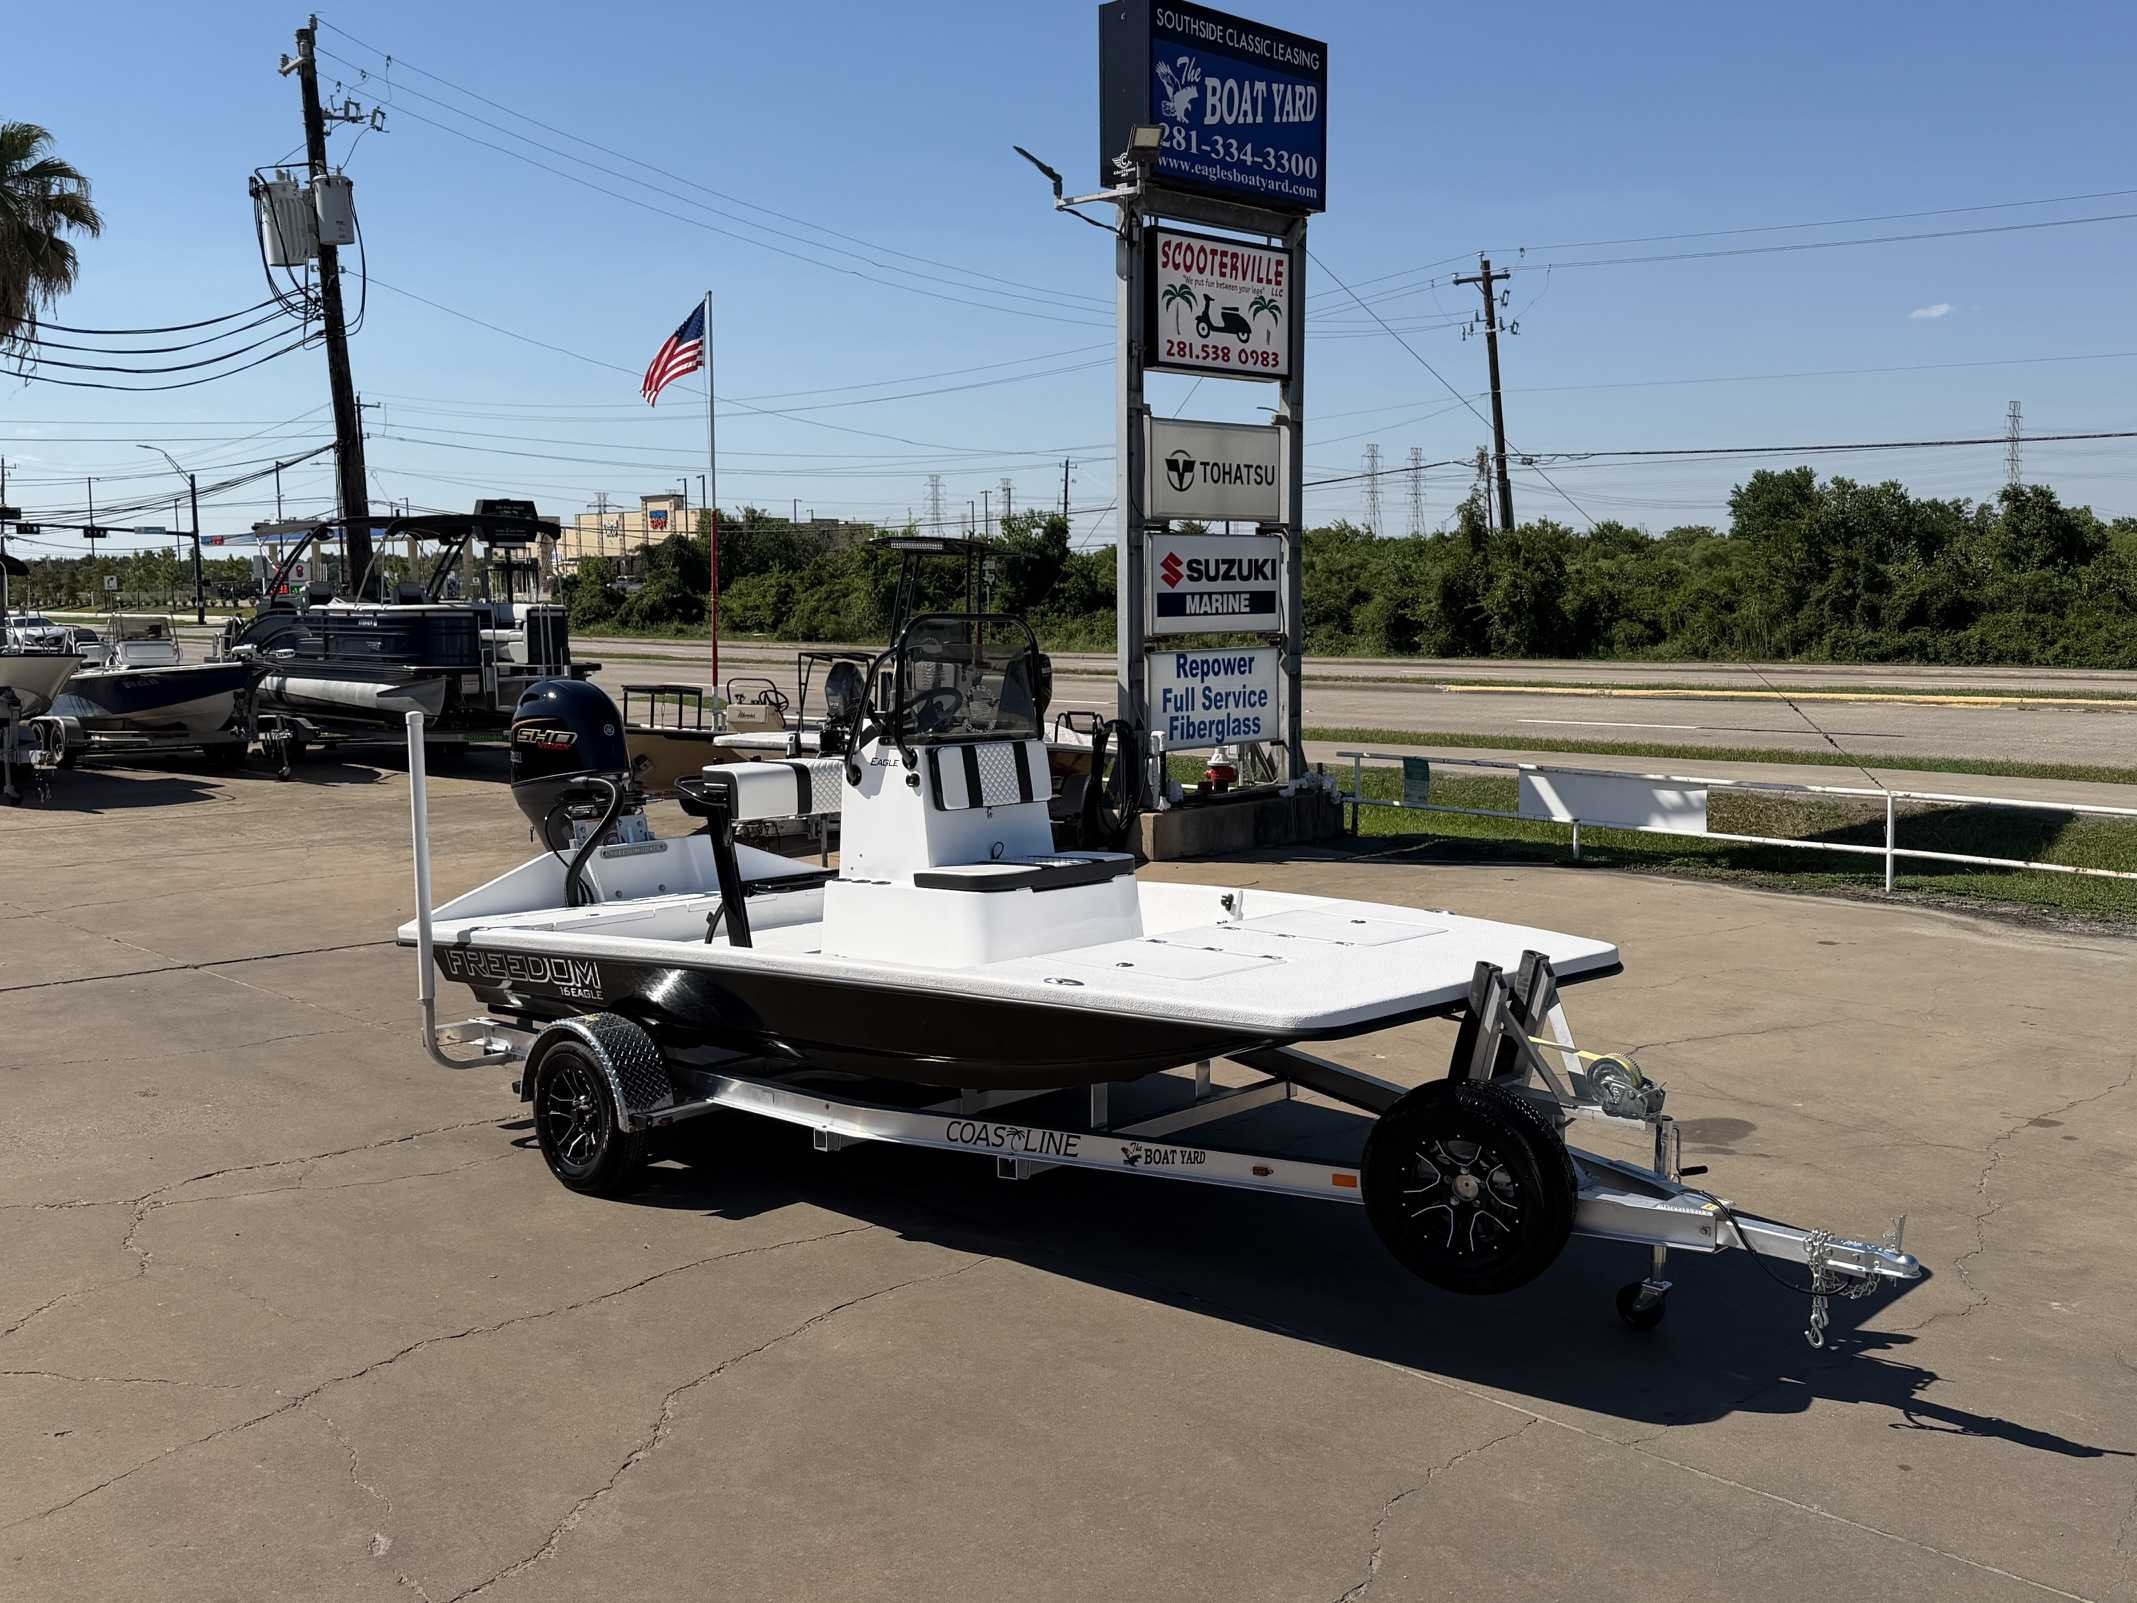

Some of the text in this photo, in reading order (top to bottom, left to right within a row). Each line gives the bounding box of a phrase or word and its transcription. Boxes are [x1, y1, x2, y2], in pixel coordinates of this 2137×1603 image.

[1156, 8, 1319, 71] SOUTHSIDE CLASSIC LEASING
[1176, 56, 1202, 85] The
[1203, 77, 1317, 126] BOAT YARD
[1158, 122, 1318, 180] 281-334-3300
[1161, 239, 1284, 287] SCOOTERVILLE
[1194, 278, 1205, 290] put
[1205, 278, 1215, 289] fun
[1238, 285, 1251, 296] your
[1271, 288, 1284, 298] LLC
[1166, 339, 1280, 368] 281.538 0983
[1199, 461, 1275, 487] TOHATSU
[1186, 558, 1277, 583] SUZUKI
[1185, 593, 1250, 615] MARINE
[1175, 653, 1255, 684] Repower
[1162, 684, 1268, 713] Full Service
[516, 728, 578, 745] SHO
[1168, 712, 1262, 745] Fiberglass
[870, 757, 900, 767] EAGLE
[444, 949, 602, 990] FREEDOM
[1144, 1147, 1206, 1166] BOAT YARD
